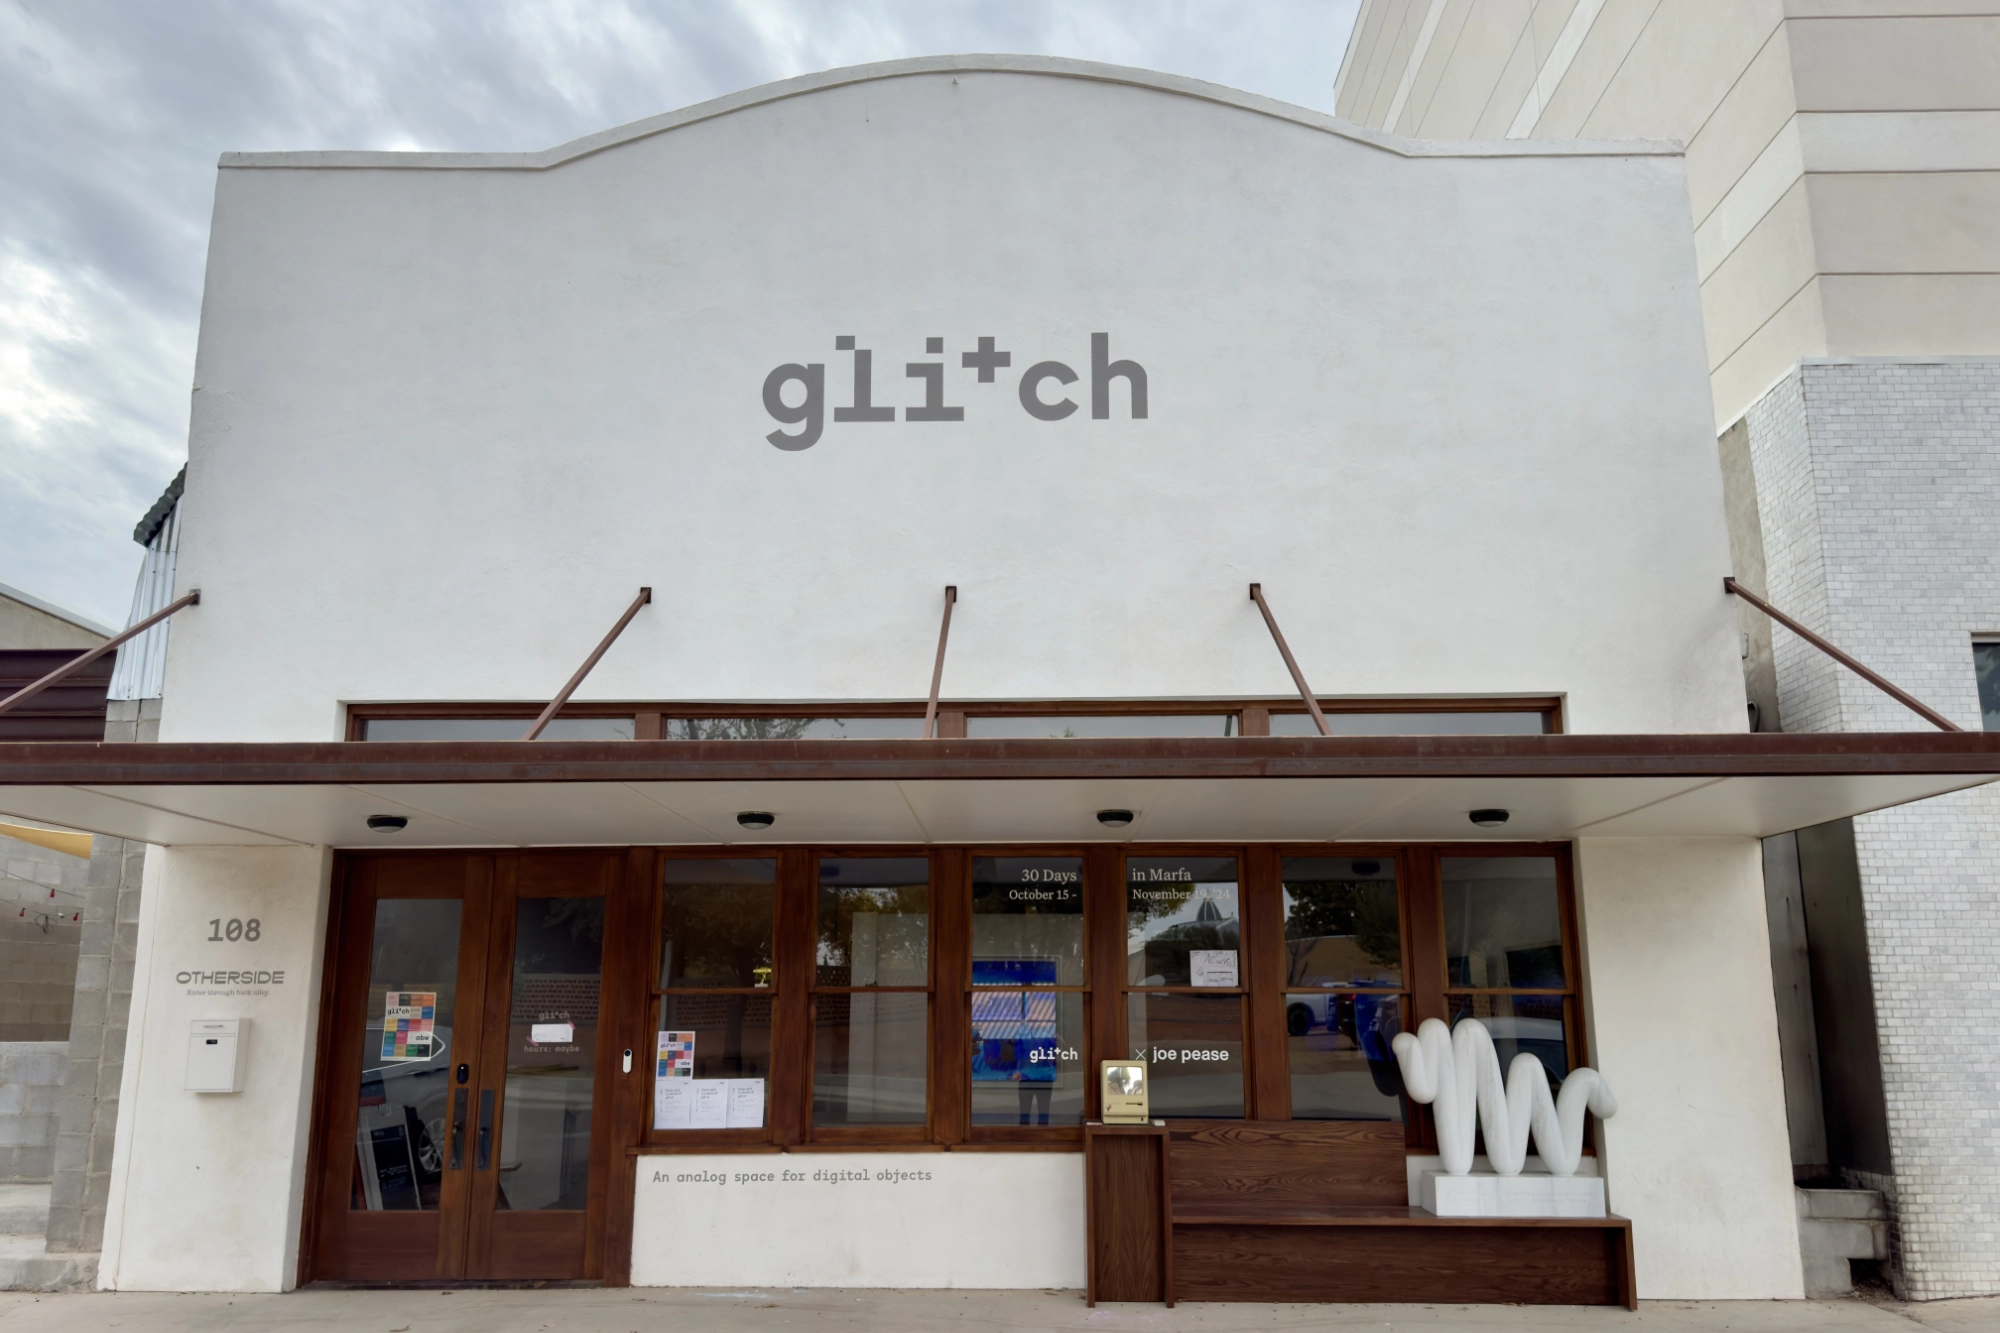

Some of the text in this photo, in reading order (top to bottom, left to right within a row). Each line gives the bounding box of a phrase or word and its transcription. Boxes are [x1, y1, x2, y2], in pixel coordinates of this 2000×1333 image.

[1021, 867, 1192, 885] 30 Days in Marfa
[1009, 889, 1054, 900] October
[1056, 889, 1069, 900] 15
[1132, 888, 1191, 900] November
[207, 918, 261, 942] 108
[176, 971, 285, 984] OTHERSIDE
[207, 989, 235, 997] through
[555, 1044, 580, 1053] maybe
[1152, 1046, 1177, 1063] joe
[1181, 1049, 1229, 1063] pease
[652, 1168, 932, 1185] An analog space for digital objects
